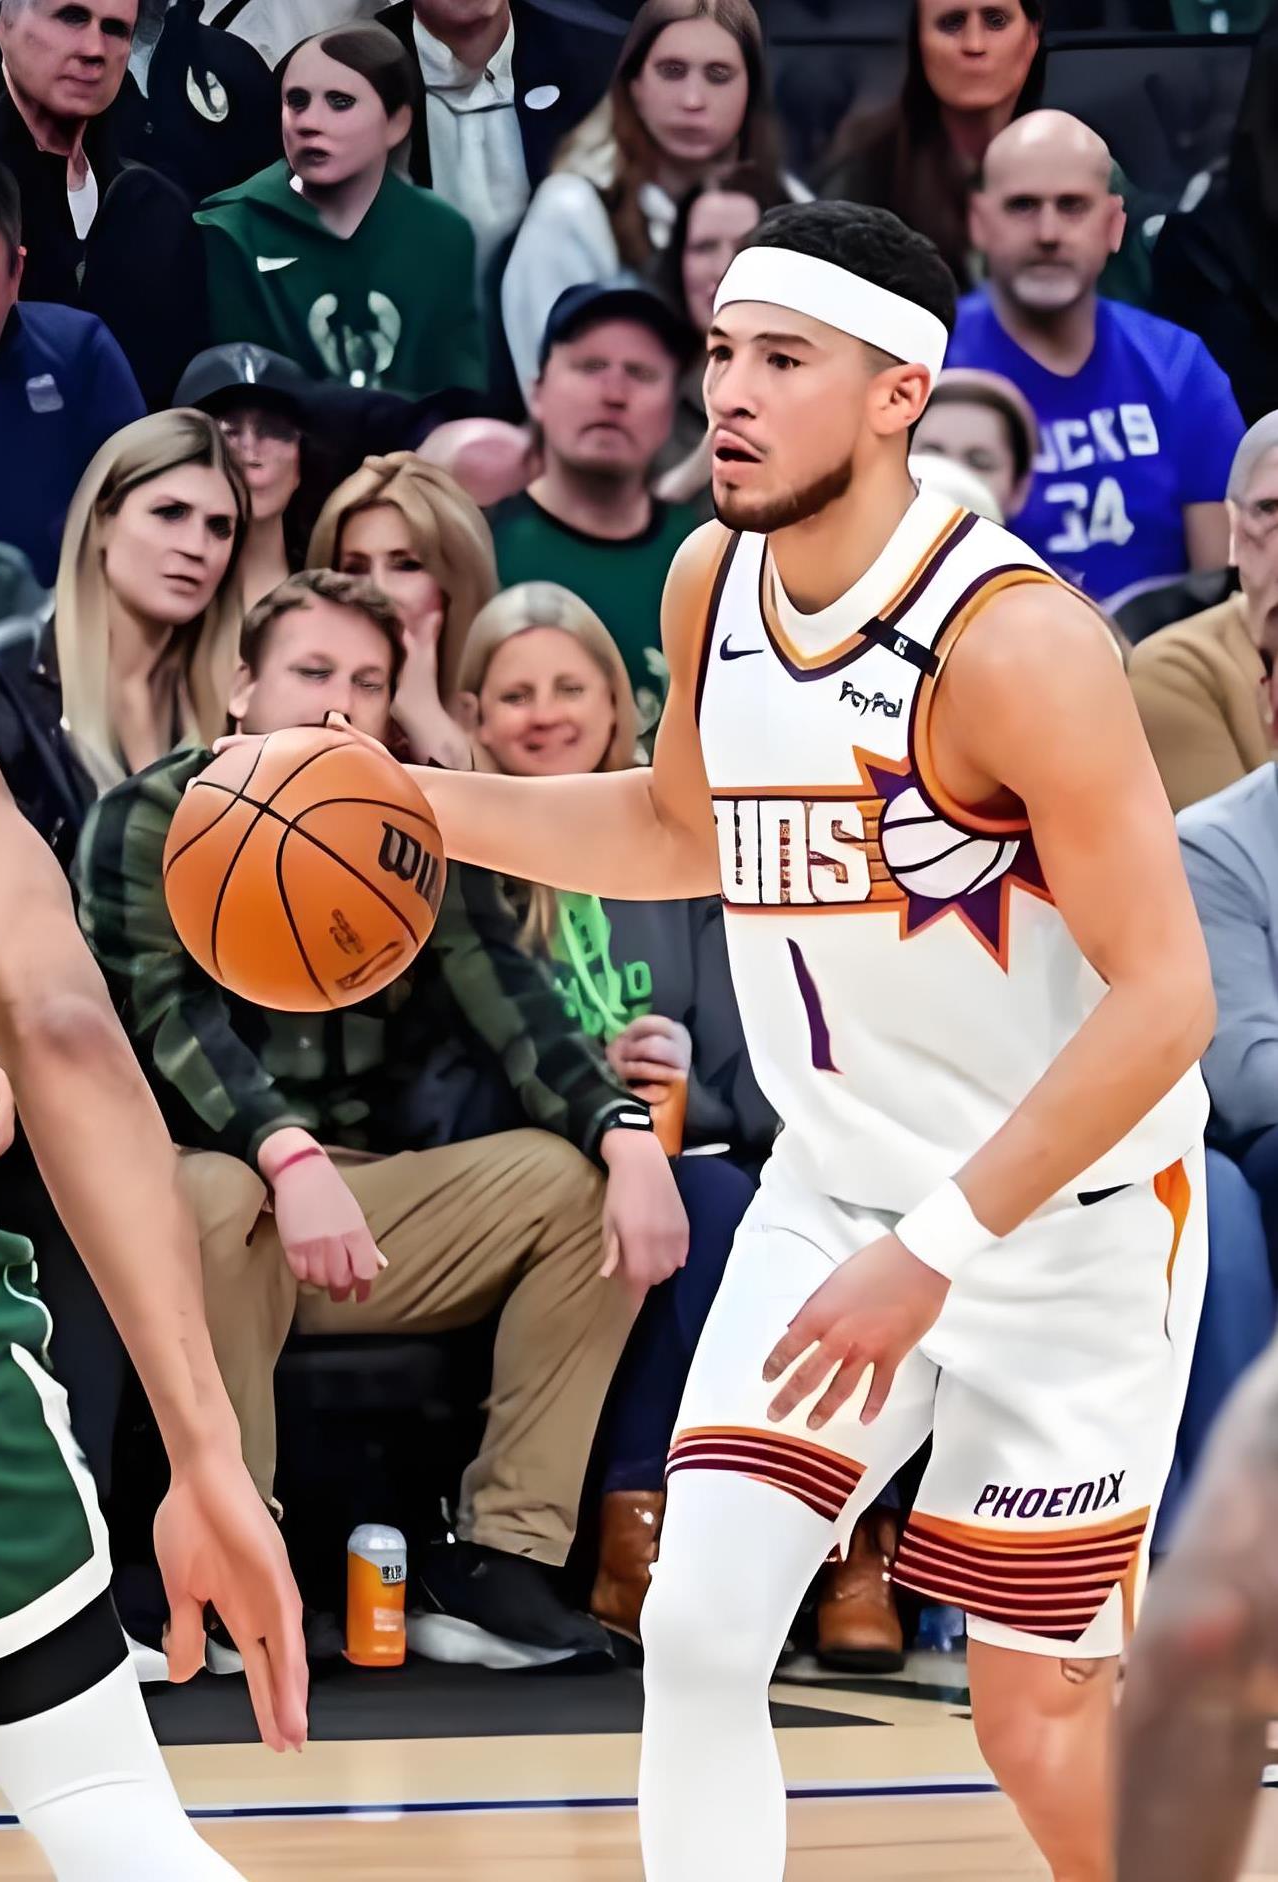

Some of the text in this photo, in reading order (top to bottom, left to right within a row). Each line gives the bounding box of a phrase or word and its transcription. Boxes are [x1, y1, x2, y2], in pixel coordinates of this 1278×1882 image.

[1033, 403, 1160, 474] UCKS
[1044, 476, 1136, 553] 34
[714, 800, 872, 904] UNS
[786, 937, 844, 1074] 1
[973, 1470, 1126, 1519] PHOENIX
